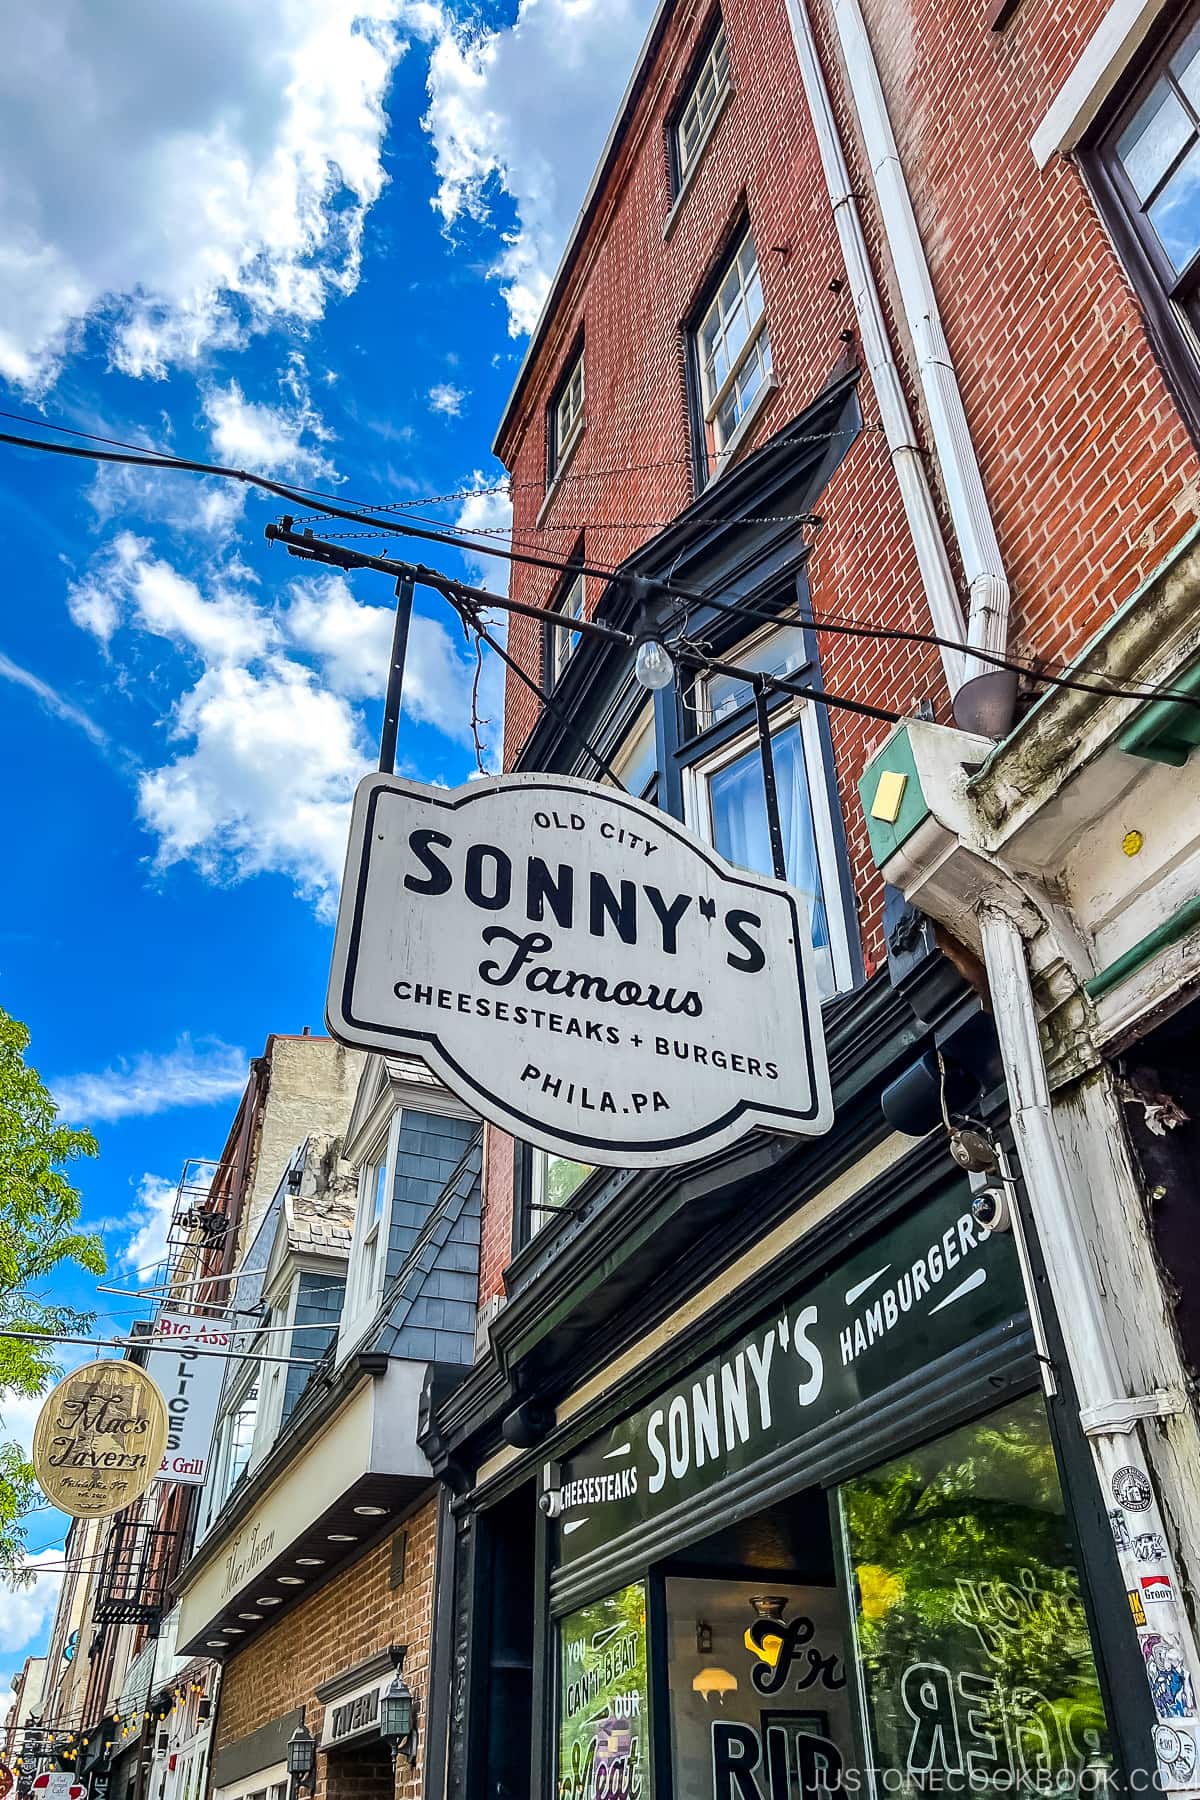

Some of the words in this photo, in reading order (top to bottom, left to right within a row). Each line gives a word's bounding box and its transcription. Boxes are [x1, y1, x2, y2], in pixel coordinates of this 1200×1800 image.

[533, 811, 587, 832] OLD
[601, 822, 658, 858] CITY
[403, 829, 767, 974] SONNY'S
[478, 926, 704, 1018] Famous
[393, 981, 620, 1046] CHEESESTEAKS
[655, 1036, 780, 1080] BURGERS
[519, 1063, 671, 1114] PHILA.PA
[56, 1395, 150, 1434] Mac's
[646, 1305, 824, 1495] SONNY'S
[49, 1437, 146, 1467] Tavern
[172, 1457, 203, 1475] Grill
[566, 1663, 601, 1719] CAN'T
[603, 1631, 639, 1689] BEAT
[567, 1637, 587, 1666] YOU
[332, 1688, 380, 1738] TAVERN
[614, 1690, 641, 1719] OUR
